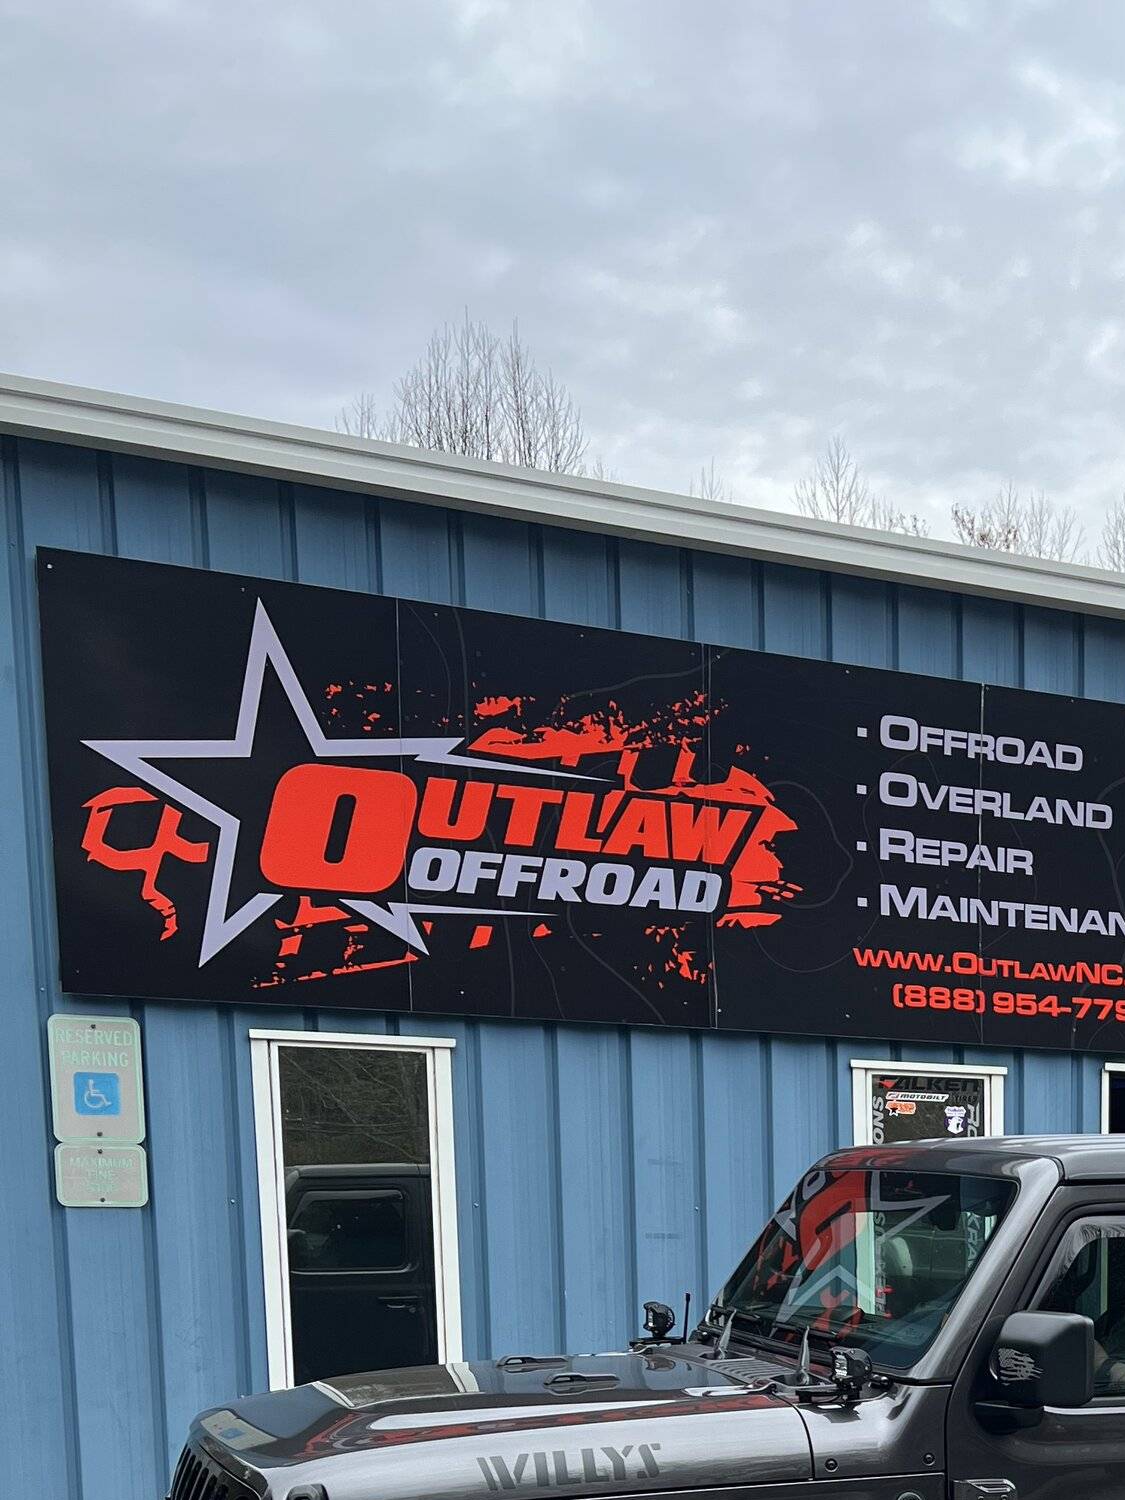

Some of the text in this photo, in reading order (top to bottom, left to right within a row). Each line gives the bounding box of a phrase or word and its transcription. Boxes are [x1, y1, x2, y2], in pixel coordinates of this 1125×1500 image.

[879, 715, 1083, 771] OFFROAD
[879, 772, 1113, 830] OVERLAND
[259, 763, 753, 893] OUTLAW
[879, 828, 1034, 875] REPAIR
[408, 846, 722, 913] OFFROAD
[892, 984, 985, 1013] (888)
[55, 1028, 133, 1046] RESERVED
[61, 1051, 129, 1067] PARKING
[900, 1093, 946, 1101] MOTOBILT
[476, 1442, 662, 1492] WILLYS
